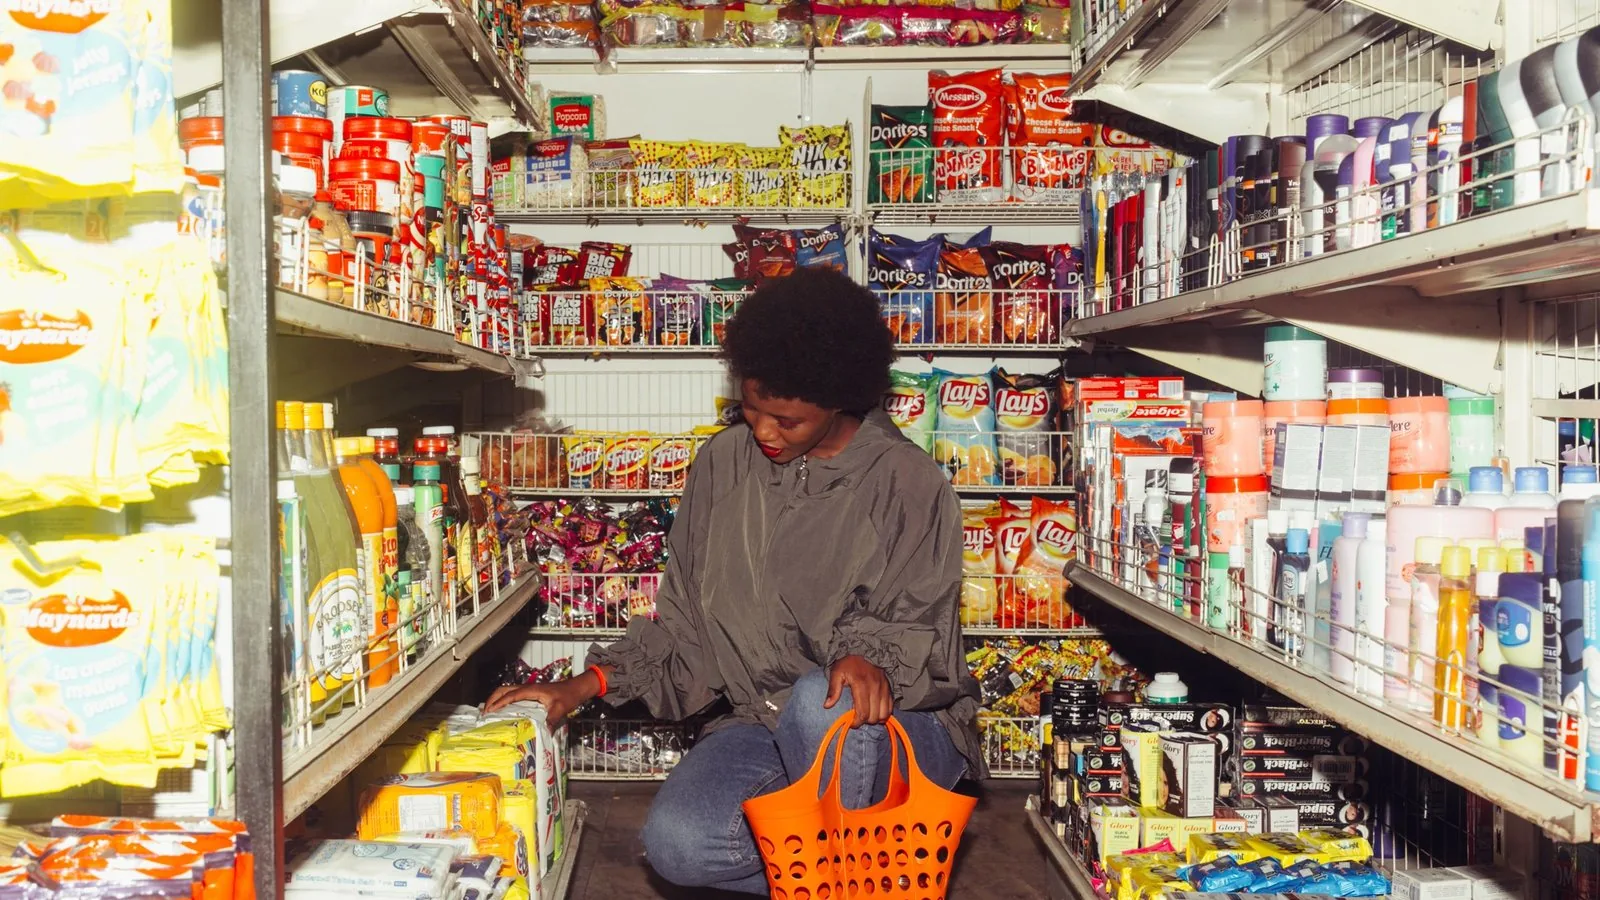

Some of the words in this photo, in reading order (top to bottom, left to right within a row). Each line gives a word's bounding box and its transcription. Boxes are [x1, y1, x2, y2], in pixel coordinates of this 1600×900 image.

[940, 91, 982, 103] Messaris
[556, 112, 588, 124] Popcorn
[870, 123, 928, 142] Doritos
[952, 124, 976, 132] Snack
[536, 145, 566, 156] opcorn
[791, 143, 829, 167] NIK
[492, 163, 509, 172] corn
[748, 176, 784, 194] NAKS
[801, 230, 840, 250] Doritos
[588, 252, 616, 270] BIG
[868, 268, 926, 286] Doritos
[993, 261, 1046, 280] Doritos
[553, 307, 581, 317] KORN
[552, 316, 581, 326] BITES
[941, 381, 990, 410] Lay's
[885, 393, 926, 421] ay's
[997, 389, 1046, 417] Lay's
[1136, 407, 1188, 417] Colgate
[1390, 421, 1411, 432] lere
[606, 448, 645, 471] Fritos
[652, 447, 691, 469] Fritos
[963, 526, 994, 557] ay's
[20, 607, 141, 634] Maynards
[1162, 742, 1182, 755] Glory
[1263, 735, 1332, 749] SuperBlack
[1263, 781, 1332, 794] SuperBlack
[1299, 803, 1336, 818] Super
[1110, 822, 1135, 831] Glory
[1150, 824, 1175, 833] Glory
[1184, 824, 1209, 833] Glory
[1218, 823, 1243, 832] Glory
